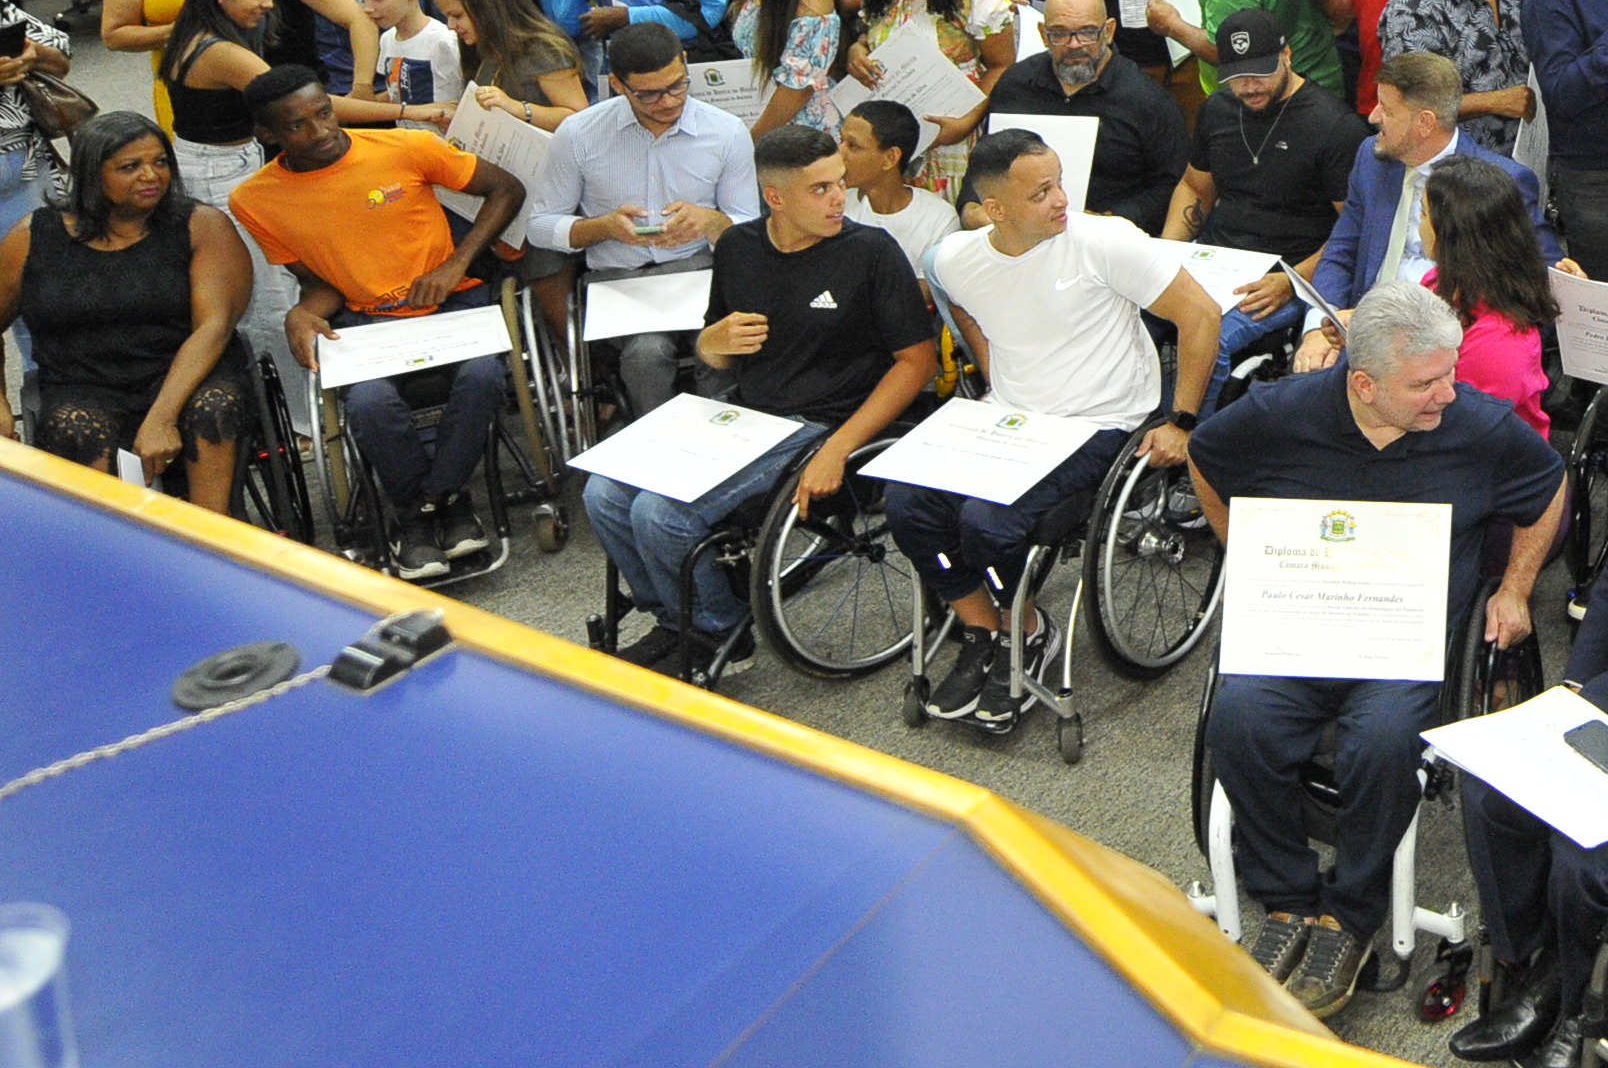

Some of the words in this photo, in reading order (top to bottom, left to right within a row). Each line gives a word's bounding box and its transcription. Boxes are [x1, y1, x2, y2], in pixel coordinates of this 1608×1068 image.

[1264, 545, 1307, 557] Diploma
[1279, 560, 1308, 569] Câmara
[1261, 590, 1287, 599] Paulo
[1289, 591, 1314, 600] Cesar
[1318, 592, 1355, 601] Marinho
[1358, 593, 1404, 603] Fernandes
